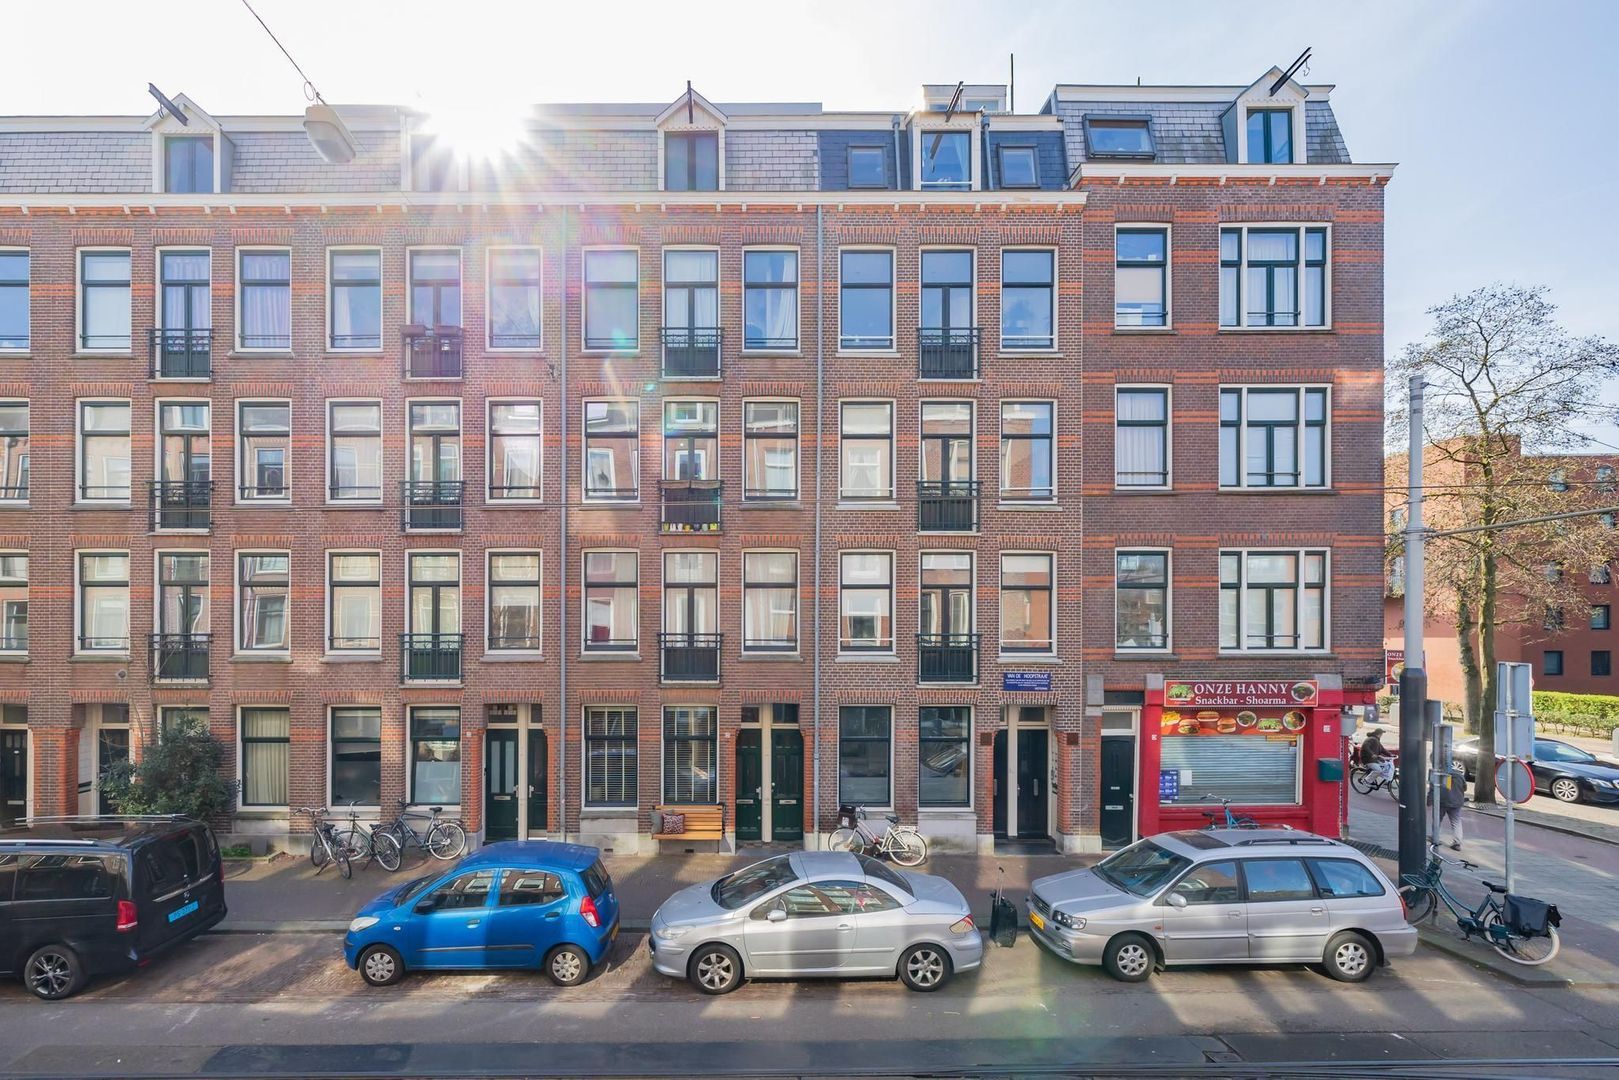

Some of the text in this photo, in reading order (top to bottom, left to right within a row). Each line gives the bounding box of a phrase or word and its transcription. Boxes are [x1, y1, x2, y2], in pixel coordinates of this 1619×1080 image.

[1194, 683, 1288, 694] ONZE HANNY
[1195, 695, 1238, 705] Snackbar
[1245, 695, 1286, 705] Shoarma
